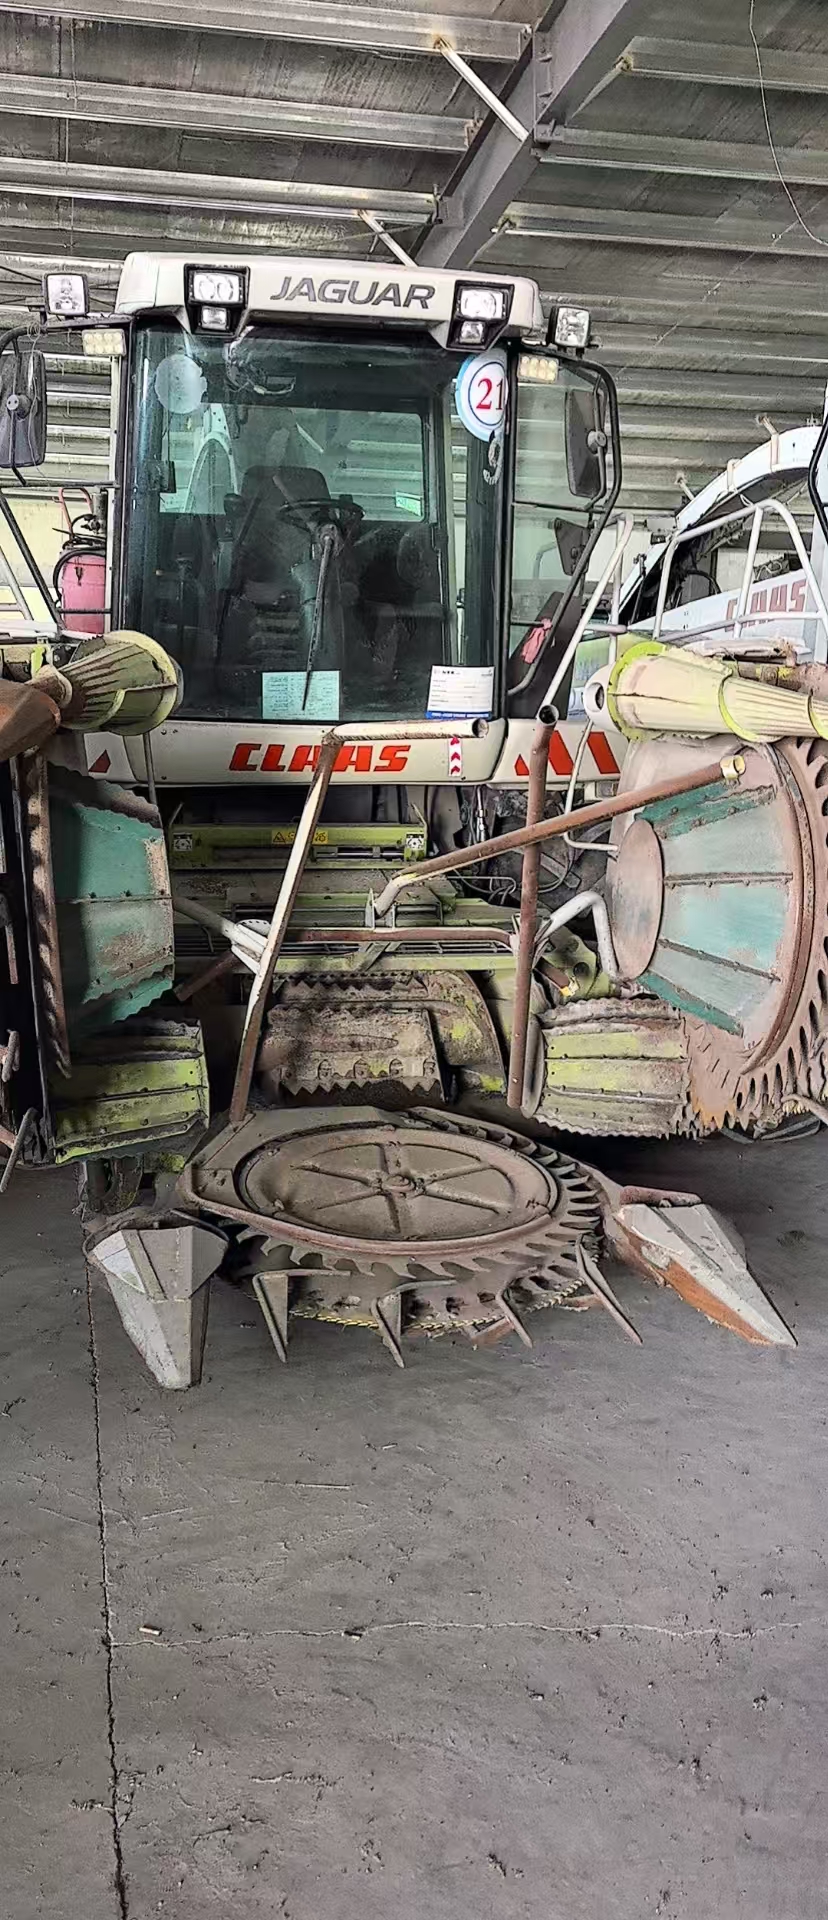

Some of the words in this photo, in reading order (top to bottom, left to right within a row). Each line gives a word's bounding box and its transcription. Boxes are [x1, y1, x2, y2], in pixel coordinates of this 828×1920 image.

[270, 276, 436, 309] JAGUAR
[475, 378, 504, 410] 21
[229, 742, 411, 772] CLAAS
